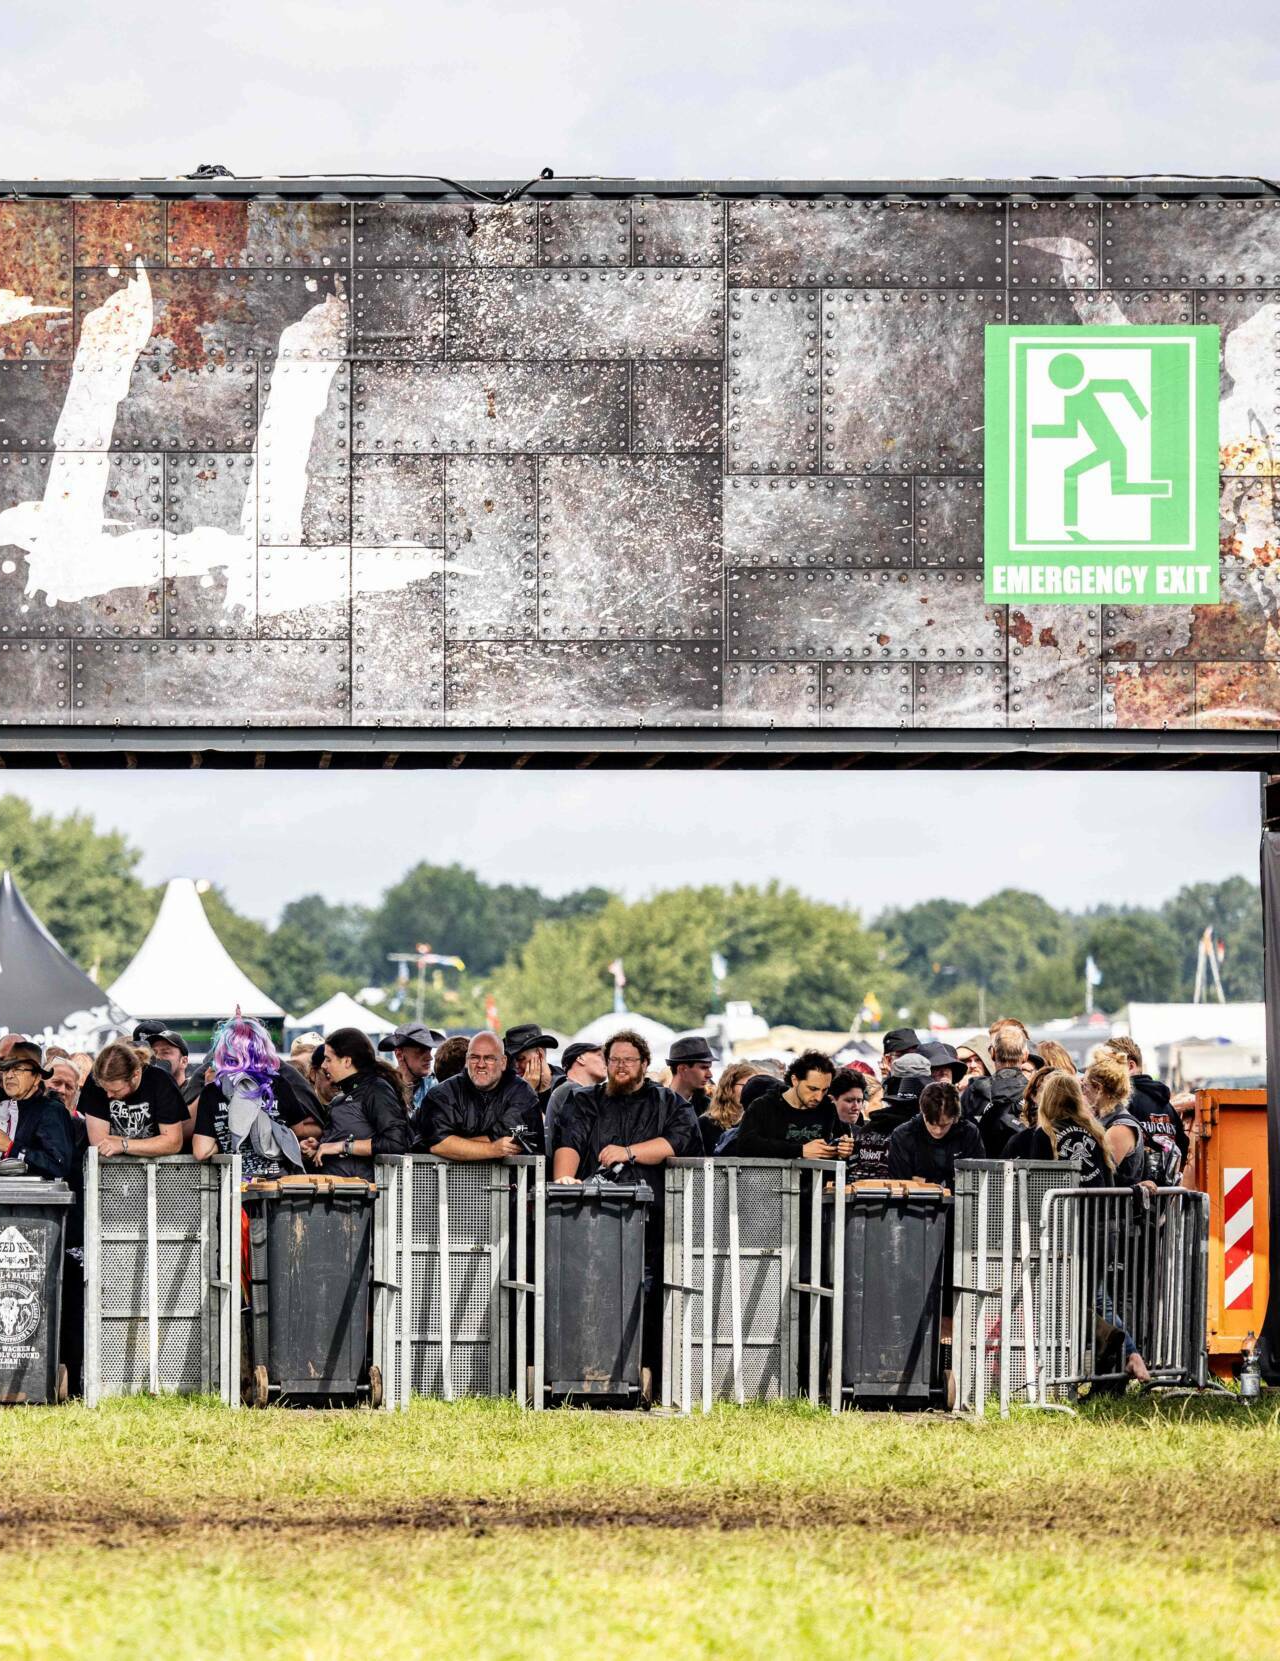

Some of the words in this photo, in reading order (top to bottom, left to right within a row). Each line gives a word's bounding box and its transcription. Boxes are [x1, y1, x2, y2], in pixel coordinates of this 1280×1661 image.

[992, 565, 1149, 595] EMERGENCY
[1155, 565, 1212, 595] EXIT
[16, 1241, 34, 1253] ME
[11, 1270, 39, 1280] NATURE
